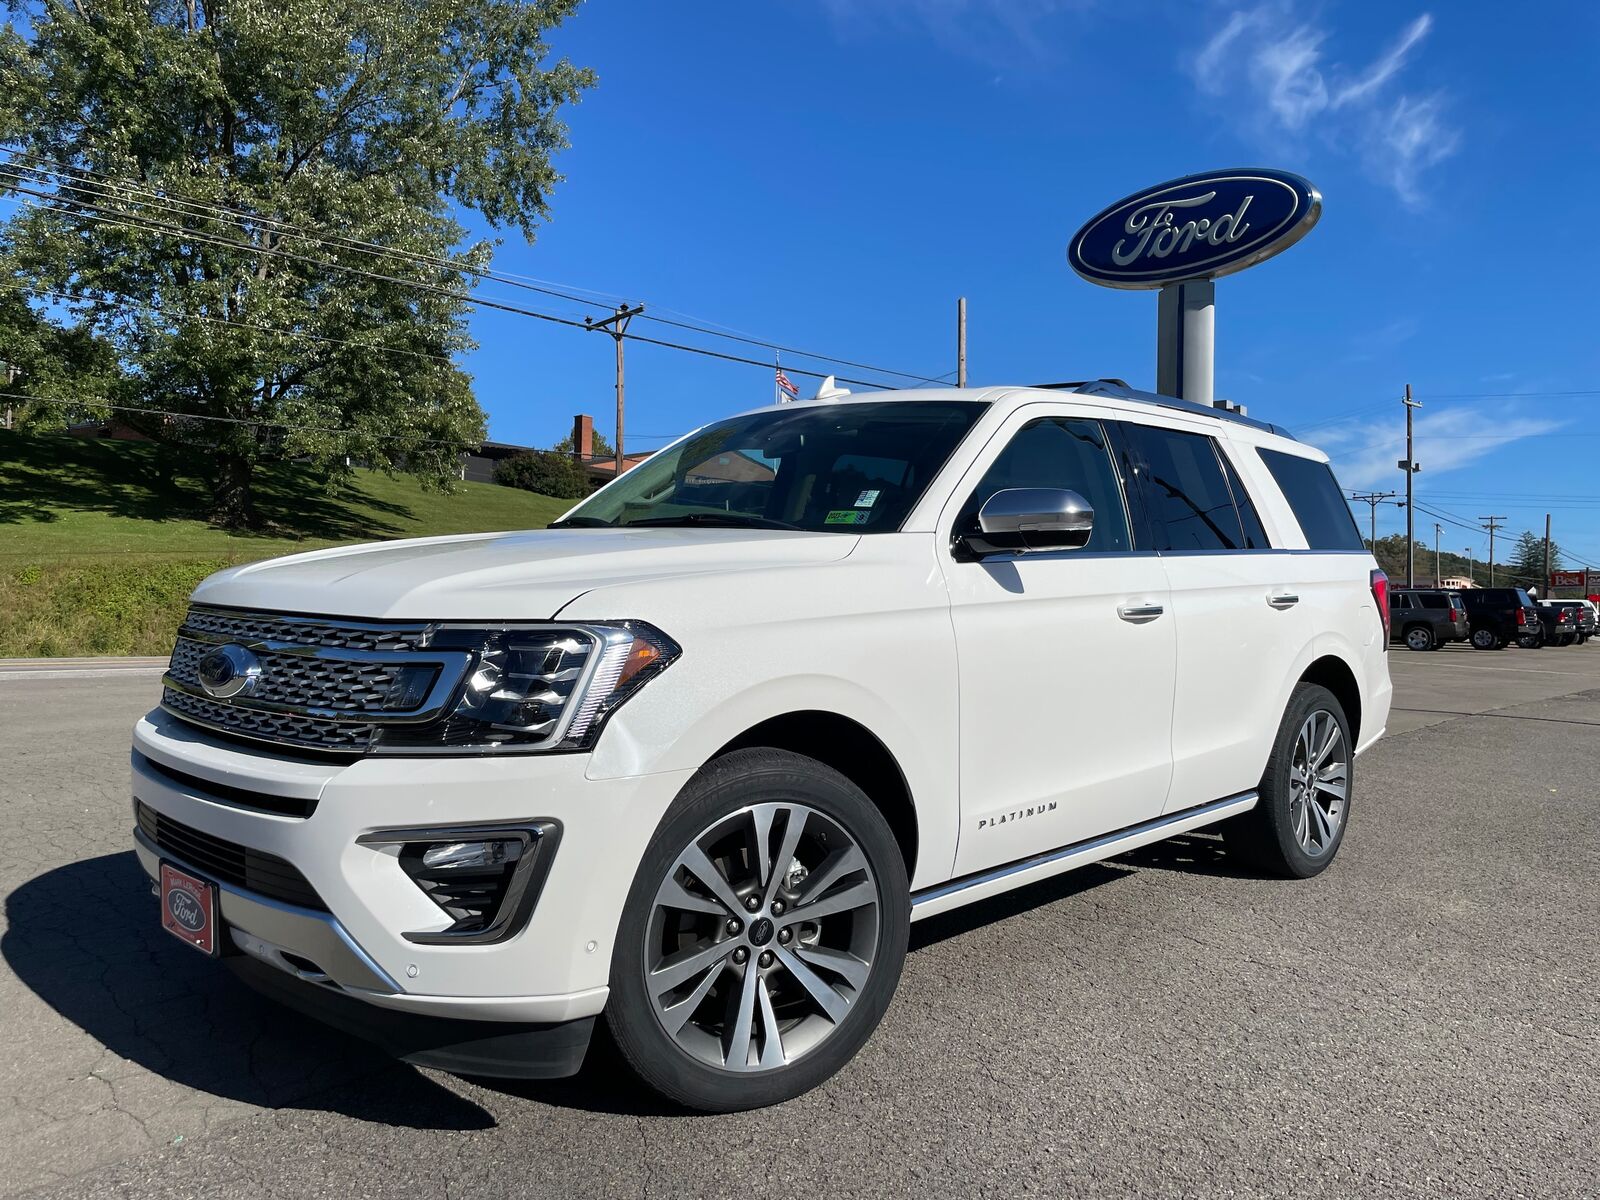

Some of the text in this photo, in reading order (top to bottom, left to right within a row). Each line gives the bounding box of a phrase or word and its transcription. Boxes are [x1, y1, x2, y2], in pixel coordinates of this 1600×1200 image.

[1111, 191, 1254, 266] Ford
[1555, 575, 1581, 586] Best
[978, 801, 1058, 830] PLATINUM
[173, 893, 198, 926] Ford
